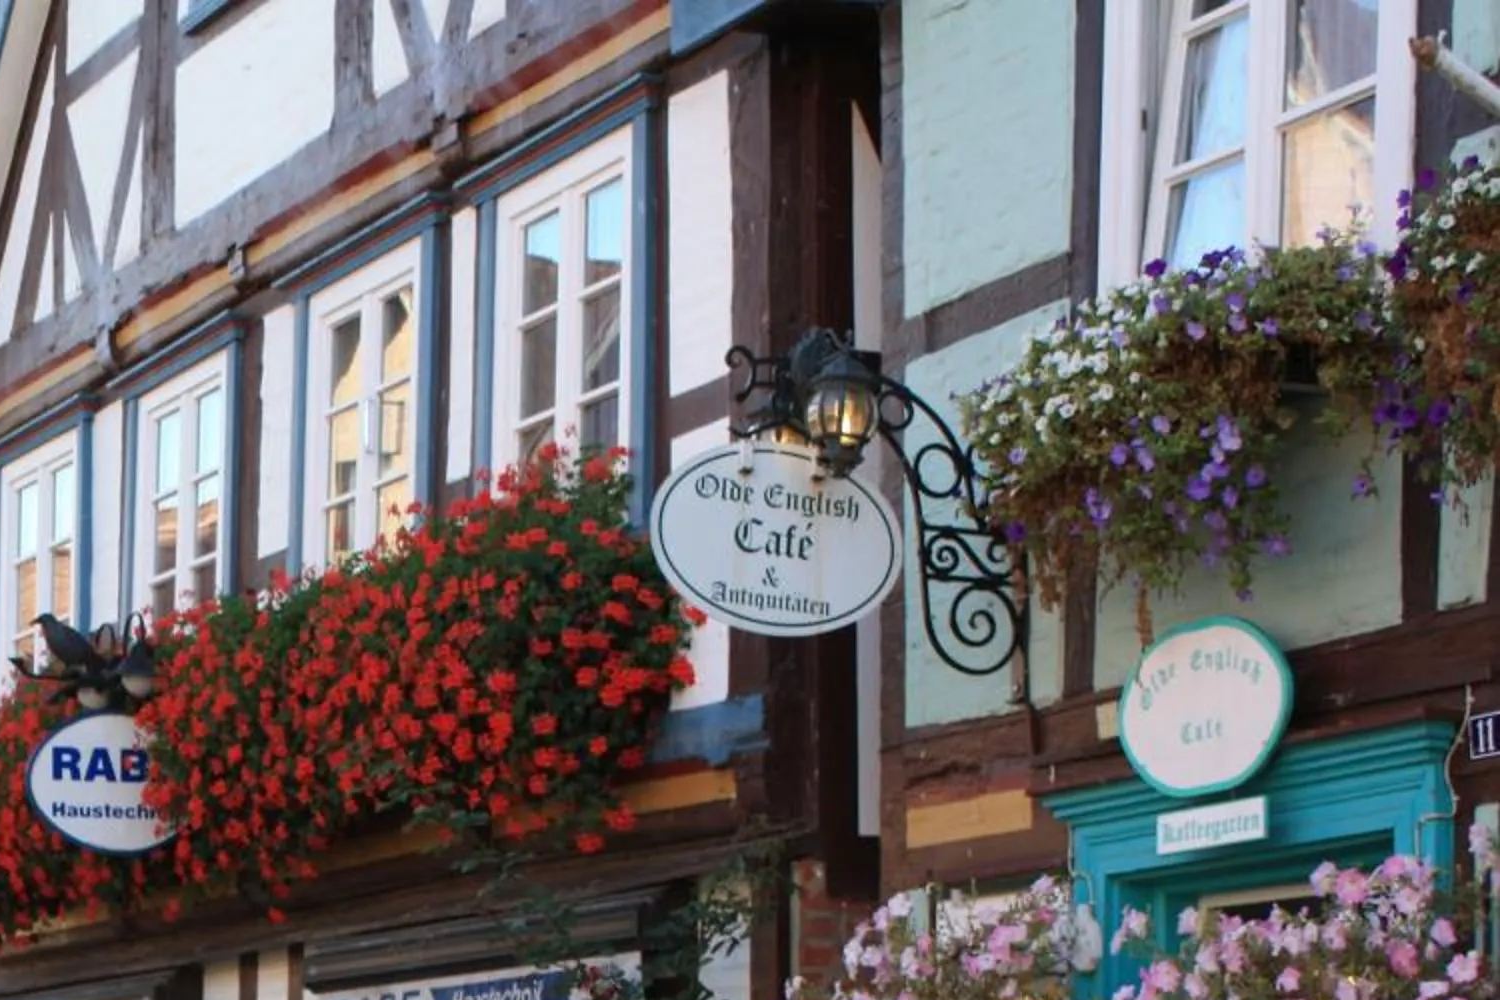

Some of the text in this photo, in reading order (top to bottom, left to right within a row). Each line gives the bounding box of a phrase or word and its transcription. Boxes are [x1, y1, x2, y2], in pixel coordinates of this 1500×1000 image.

[695, 473, 860, 522] Olde English
[734, 518, 814, 561] Café
[762, 566, 779, 588] &
[711, 581, 831, 617] Antiquitäten
[1190, 646, 1263, 685] English
[1476, 718, 1495, 752] 11
[52, 746, 148, 783] RAB
[52, 801, 156, 820] Haustech
